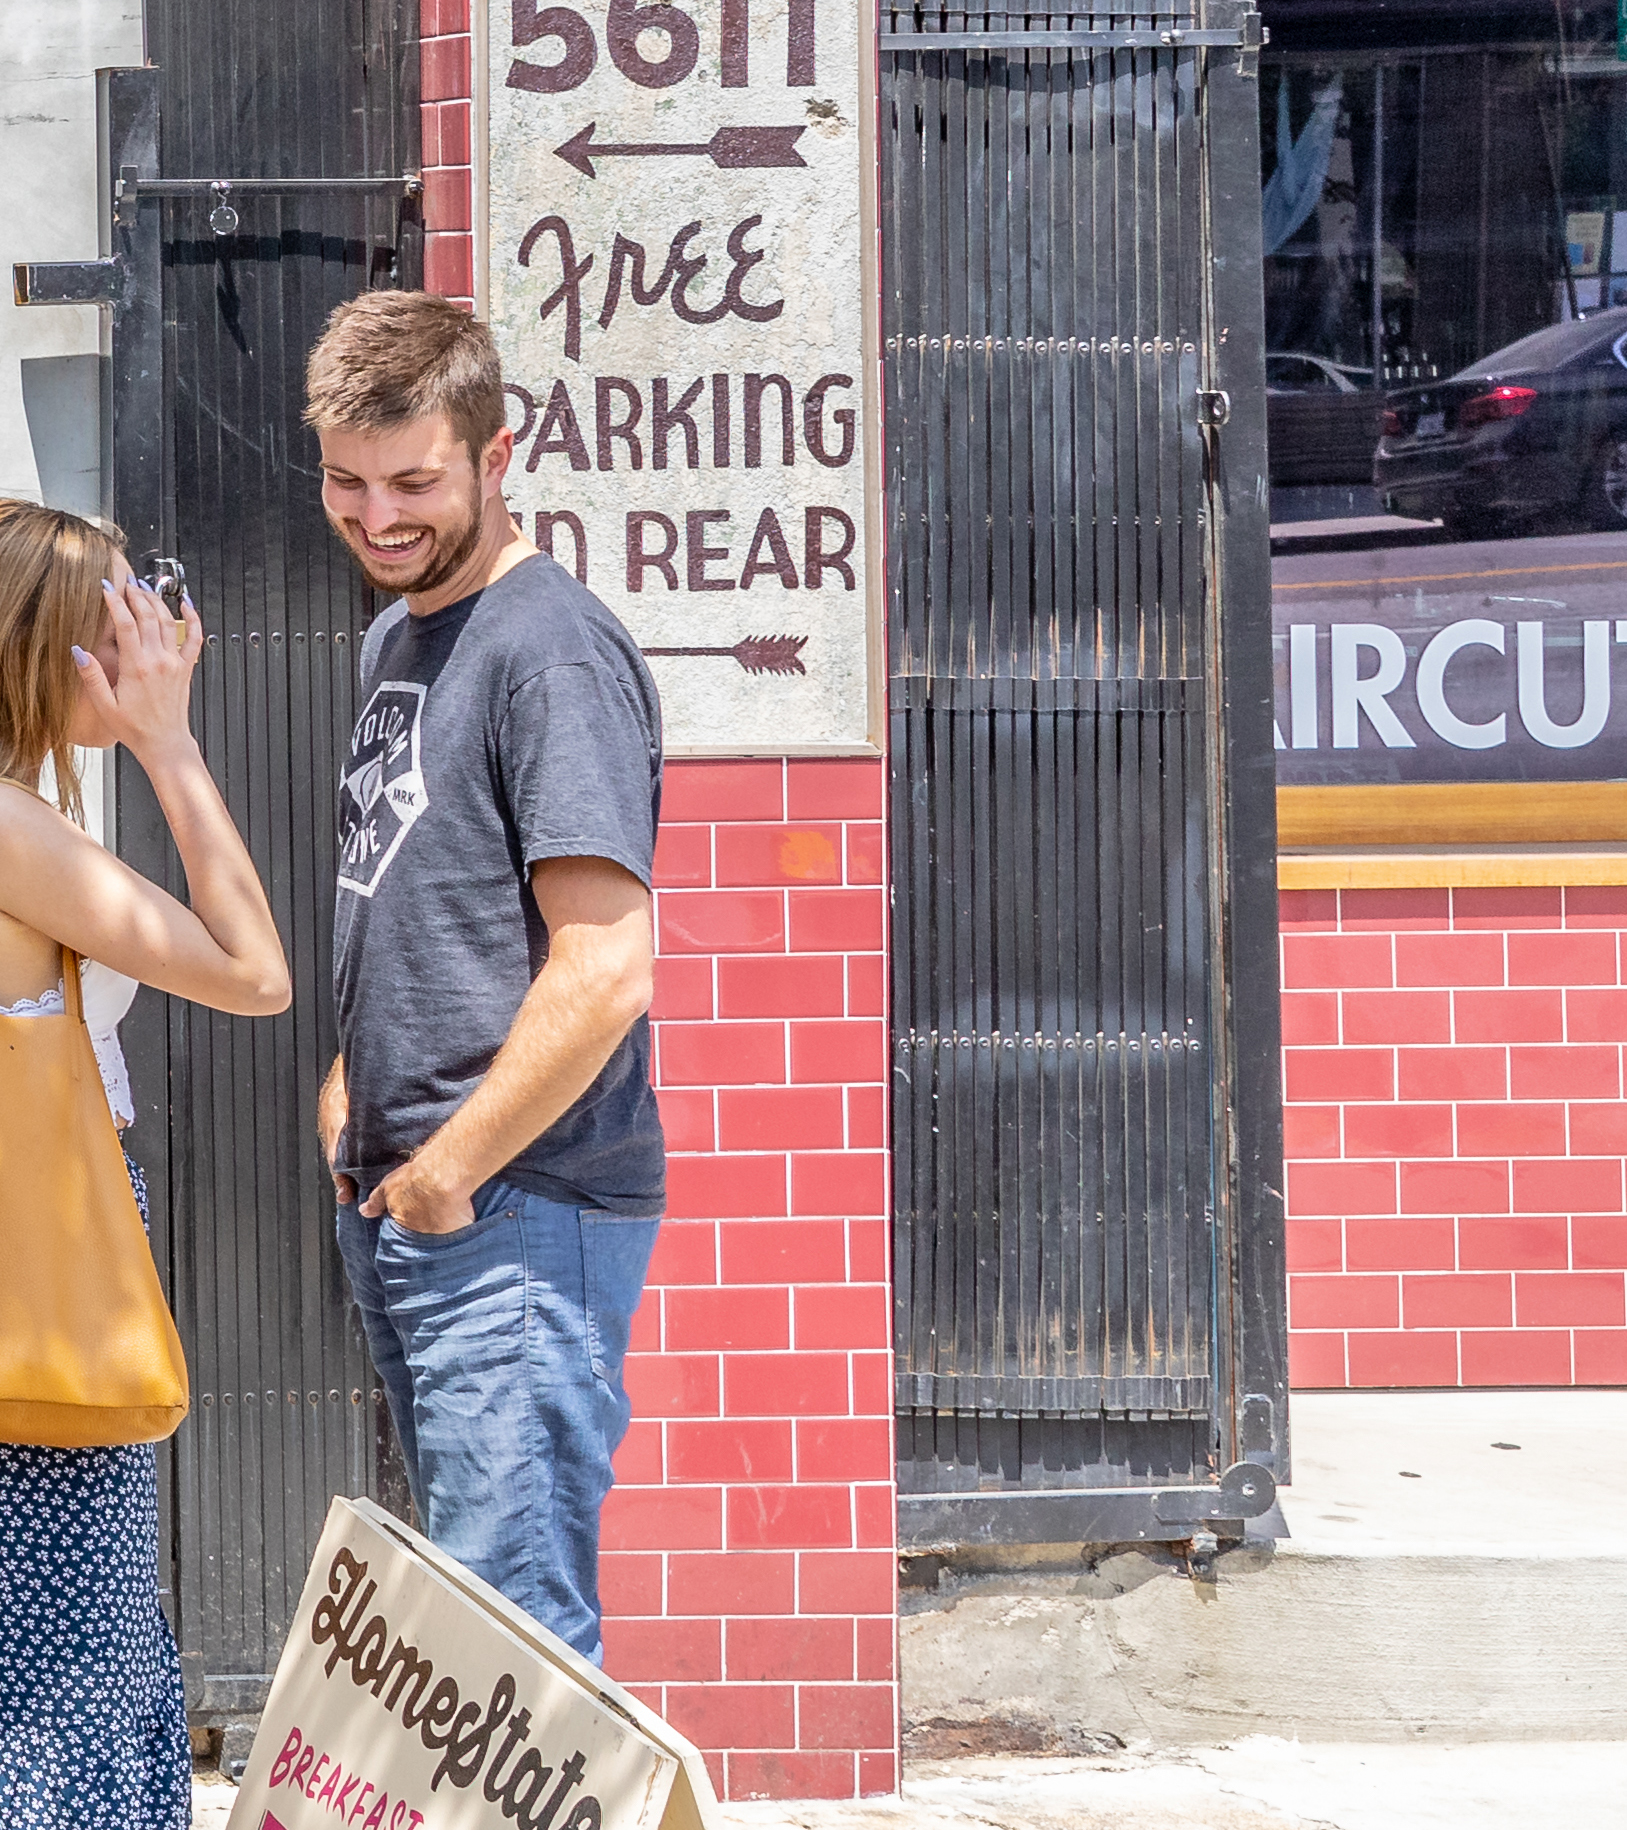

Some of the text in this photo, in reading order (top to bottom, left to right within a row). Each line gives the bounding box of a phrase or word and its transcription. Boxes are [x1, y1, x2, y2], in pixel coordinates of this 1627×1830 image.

[626, 506, 856, 593] REAR
[1272, 618, 1627, 750] IRCU
[392, 788, 416, 807] MRK
[310, 1546, 603, 1830] HomeState
